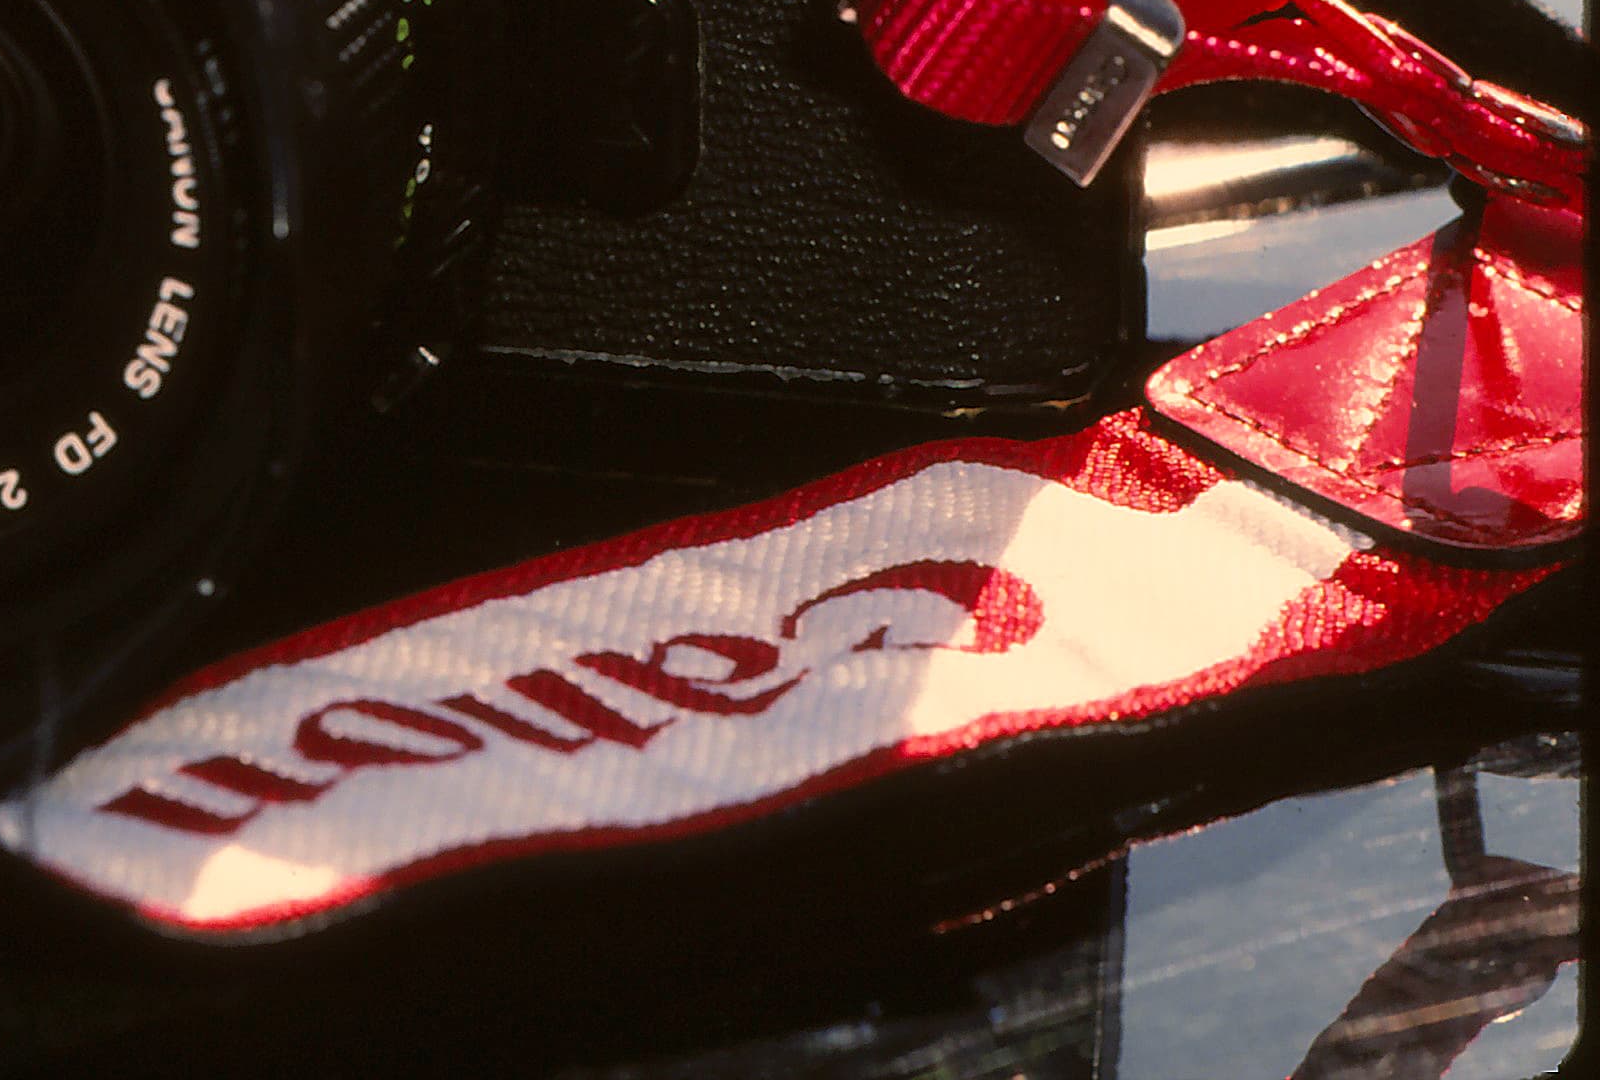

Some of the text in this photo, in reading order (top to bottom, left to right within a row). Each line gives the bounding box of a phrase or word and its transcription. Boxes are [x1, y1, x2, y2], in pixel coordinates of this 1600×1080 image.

[123, 276, 196, 400] LENS
[53, 410, 119, 476] FD
[101, 559, 1044, 836] Canon
